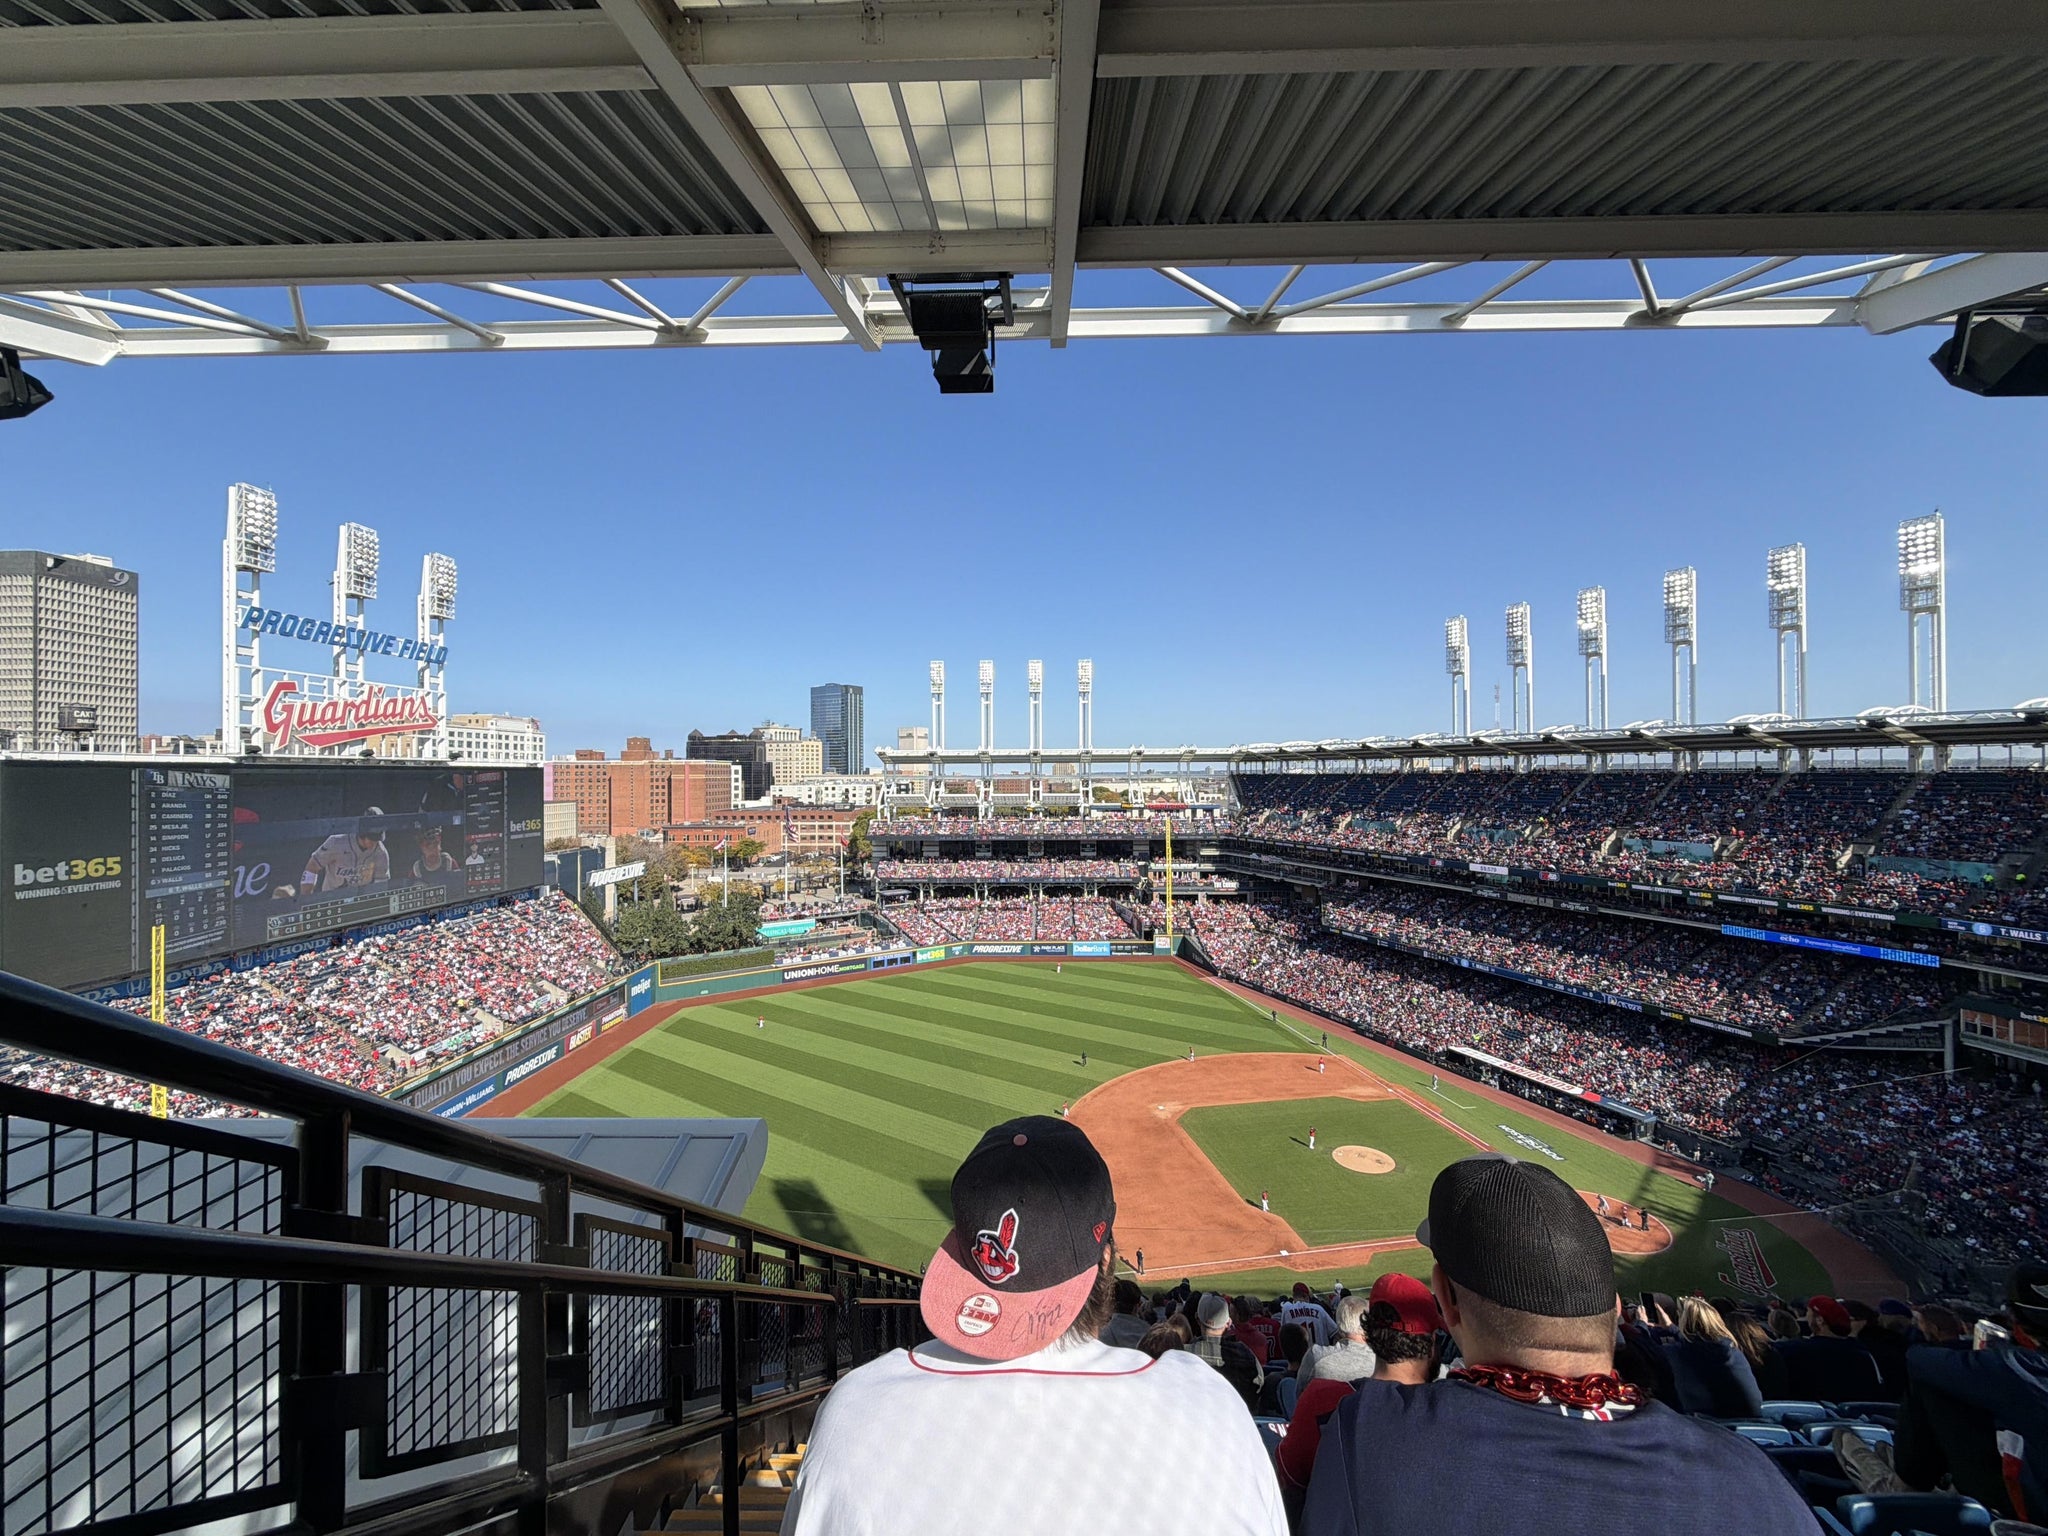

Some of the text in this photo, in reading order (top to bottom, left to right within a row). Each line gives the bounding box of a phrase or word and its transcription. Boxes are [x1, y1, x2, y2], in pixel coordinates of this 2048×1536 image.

[239, 605, 449, 665] PROGRESSIVE FIELD
[263, 680, 439, 750] Guardians
[181, 772, 217, 788] RAYS
[510, 820, 541, 832] bet365
[14, 856, 122, 885] bet365
[589, 861, 646, 887] PROGRESSIVE
[15, 887, 60, 900] WINNING
[68, 880, 122, 894] EVERYTHING
[1689, 890, 1712, 898] bet365
[454, 901, 488, 916] HONDA
[1560, 902, 1575, 910] drug
[1787, 902, 1814, 912] bet365
[378, 917, 423, 932] HONDA
[1779, 932, 1800, 944] echo
[2000, 928, 2042, 940] T. WALLS
[278, 937, 333, 957] HONDA
[972, 945, 1023, 954] PROGRESSIVE
[1074, 944, 1109, 952] DollarBank
[916, 950, 945, 961] bet365
[784, 964, 840, 980] UNIONHOME
[631, 979, 652, 997] meijer
[1660, 1010, 1684, 1021] bet365
[569, 1025, 592, 1051] BLASTER
[414, 1078, 454, 1109] QUALITY
[455, 1068, 473, 1088] YOU
[474, 1052, 505, 1078] EXPECT.
[506, 1043, 520, 1061] THE
[520, 1027, 548, 1052] SERVICE
[548, 1022, 562, 1038] YOU
[504, 1045, 559, 1086] PROGRESSIVE
[1499, 1061, 1574, 1092] GUARDIANS
[1290, 1306, 1320, 1319] RAMÍREZ
